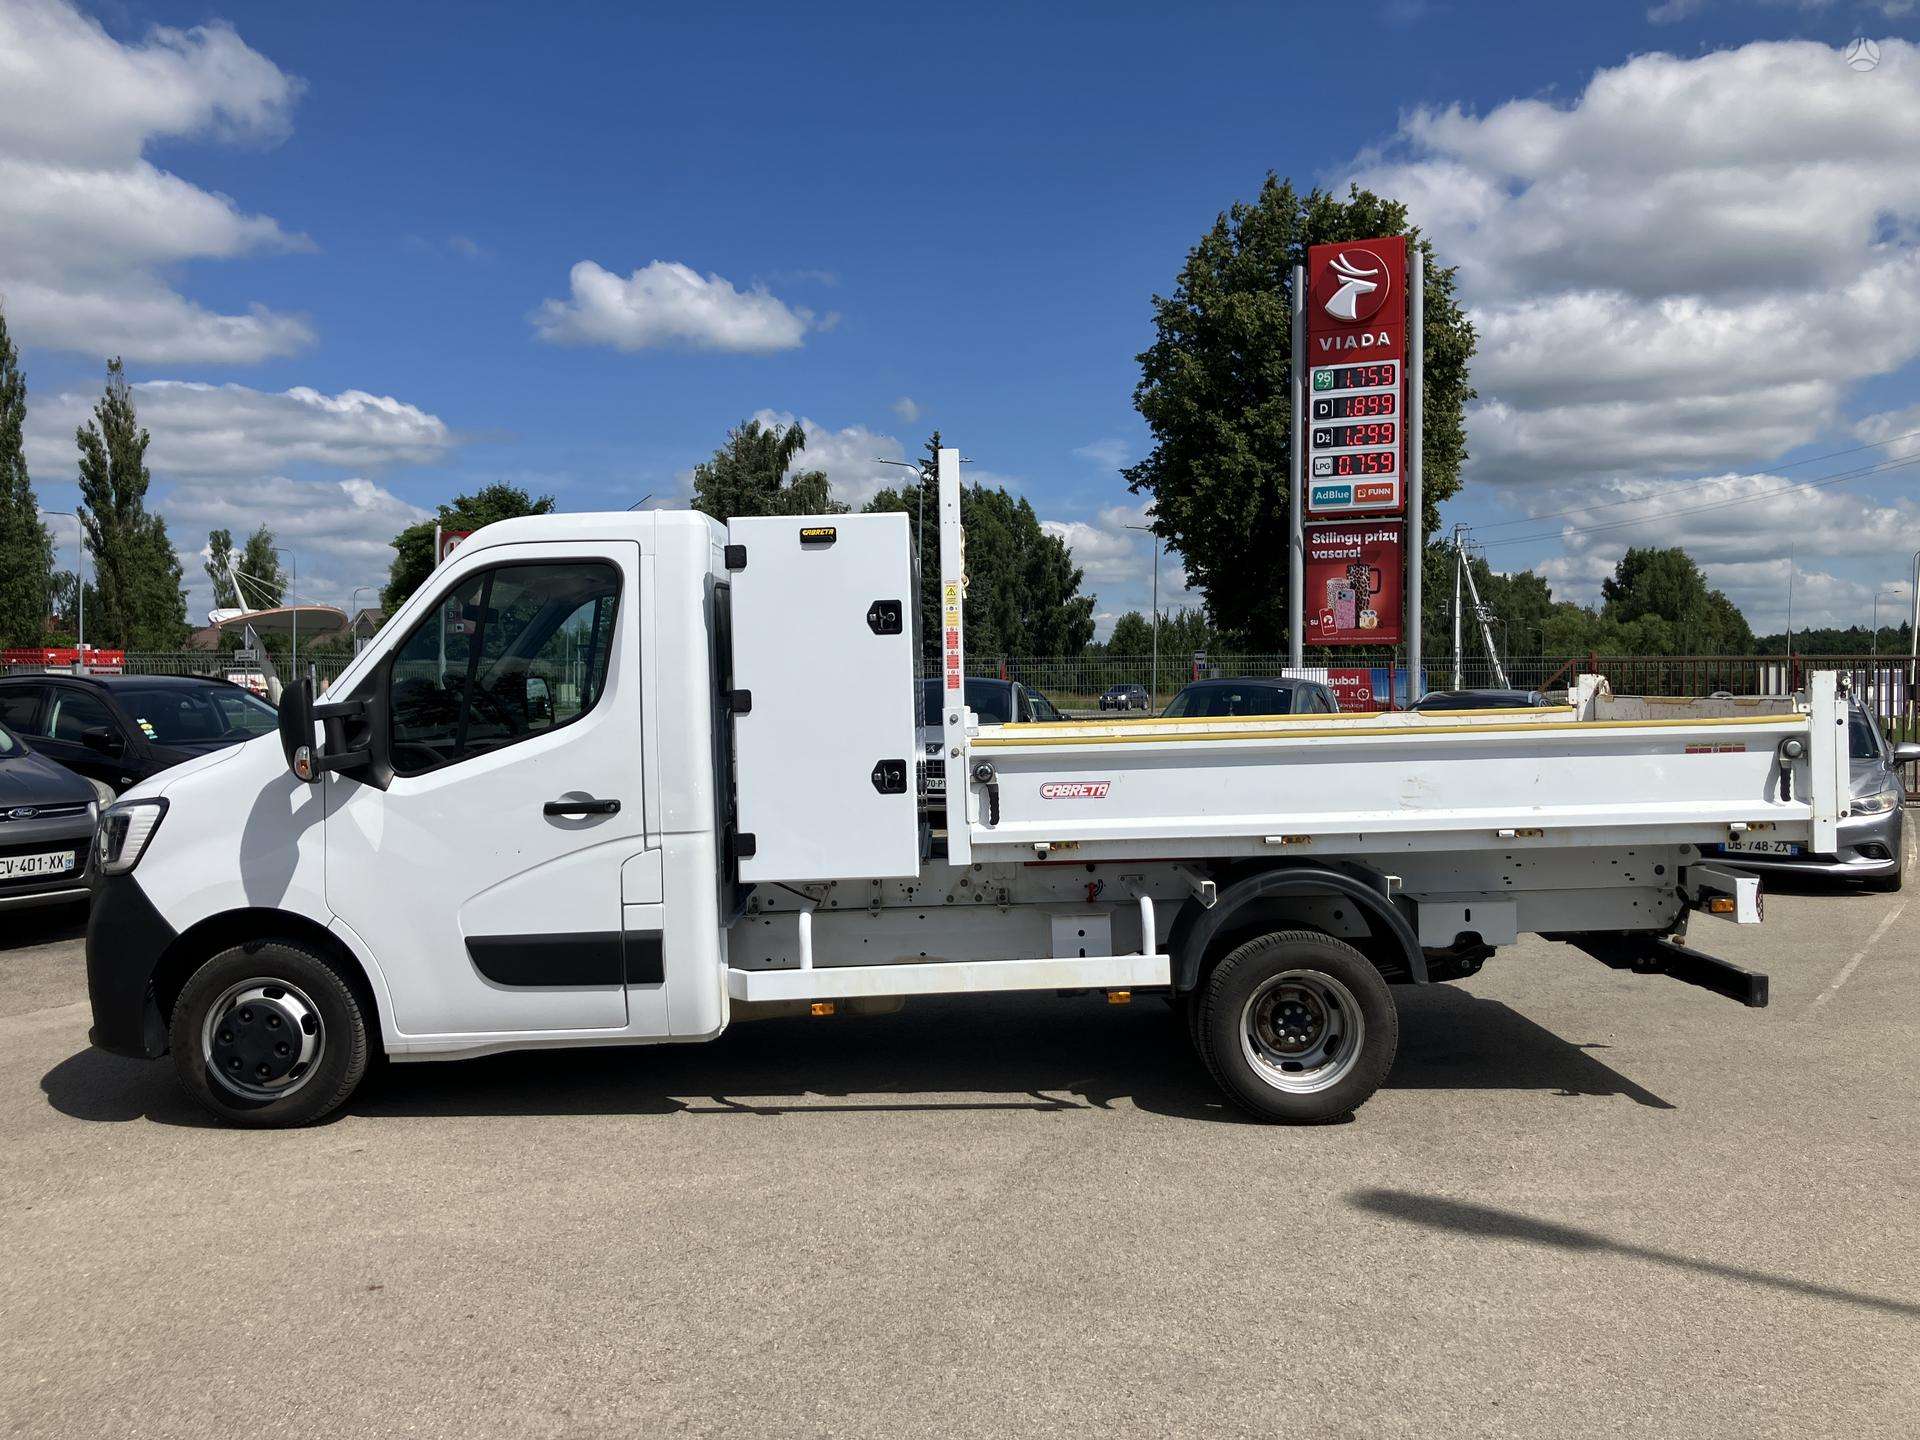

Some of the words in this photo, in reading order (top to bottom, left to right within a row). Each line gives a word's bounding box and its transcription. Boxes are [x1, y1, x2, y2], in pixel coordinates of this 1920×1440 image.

[1319, 331, 1391, 352] VIADA
[1317, 371, 1331, 383] 95
[1346, 365, 1393, 388] 1.759
[1319, 403, 1329, 414] D
[1346, 394, 1393, 417] 1.899
[1346, 423, 1393, 446] 1.299
[1315, 462, 1331, 471] LPG
[1338, 452, 1393, 475] 0.759
[1315, 489, 1350, 500] AdBlue
[1367, 487, 1391, 496] FUNN
[802, 528, 835, 536] CABRETA
[1312, 546, 1361, 559] vasara!
[1042, 783, 1109, 797] CABRETA
